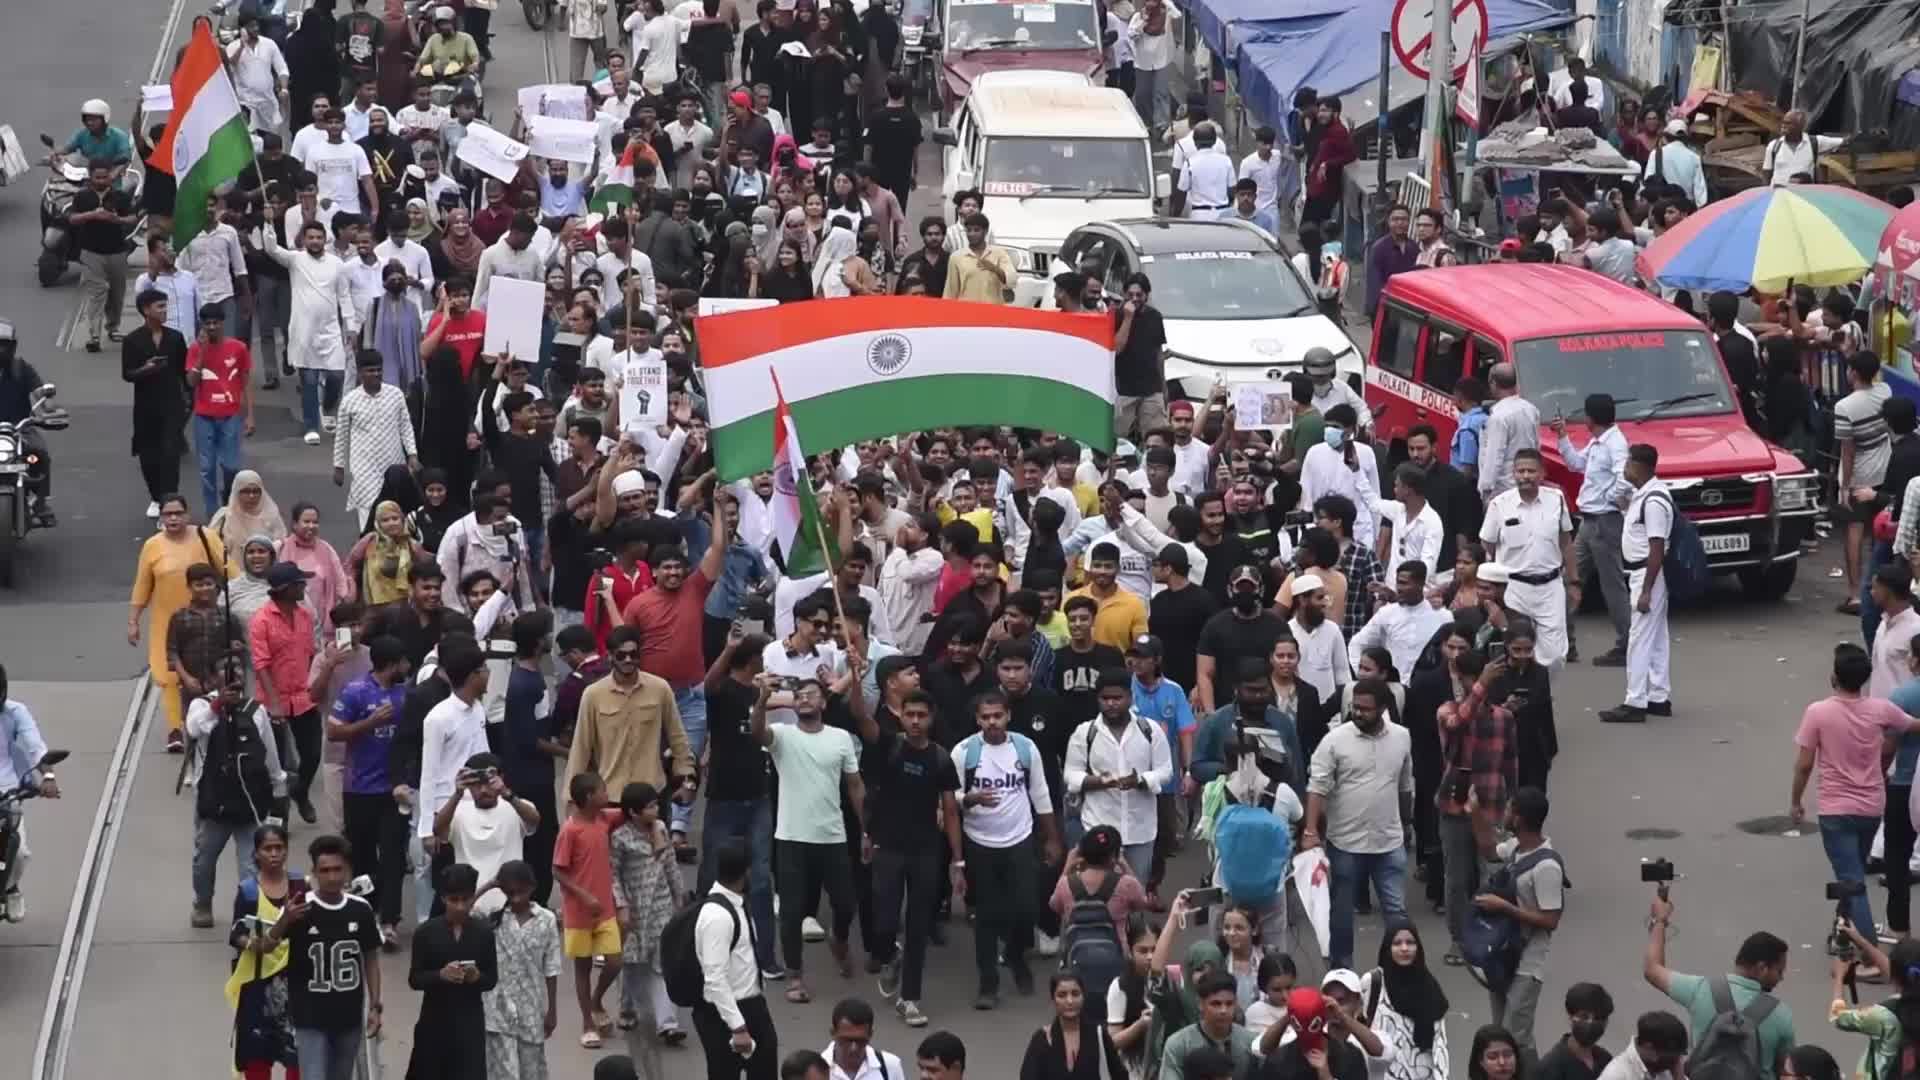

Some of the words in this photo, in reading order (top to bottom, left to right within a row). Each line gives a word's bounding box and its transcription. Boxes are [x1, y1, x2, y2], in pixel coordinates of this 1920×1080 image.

[991, 183, 1028, 193] POLICE
[1175, 252, 1218, 261] KOLKATA
[1219, 251, 1253, 260] POLICE
[1558, 337, 1618, 353] KOLKATA
[1619, 334, 1664, 350] POLICE
[639, 367, 662, 376] STAND
[627, 376, 661, 385] TOGETHER
[1378, 371, 1410, 397] KOLKATA
[1421, 388, 1455, 417] POLICE
[1063, 667, 1099, 690] GAP
[308, 940, 360, 992] 16
